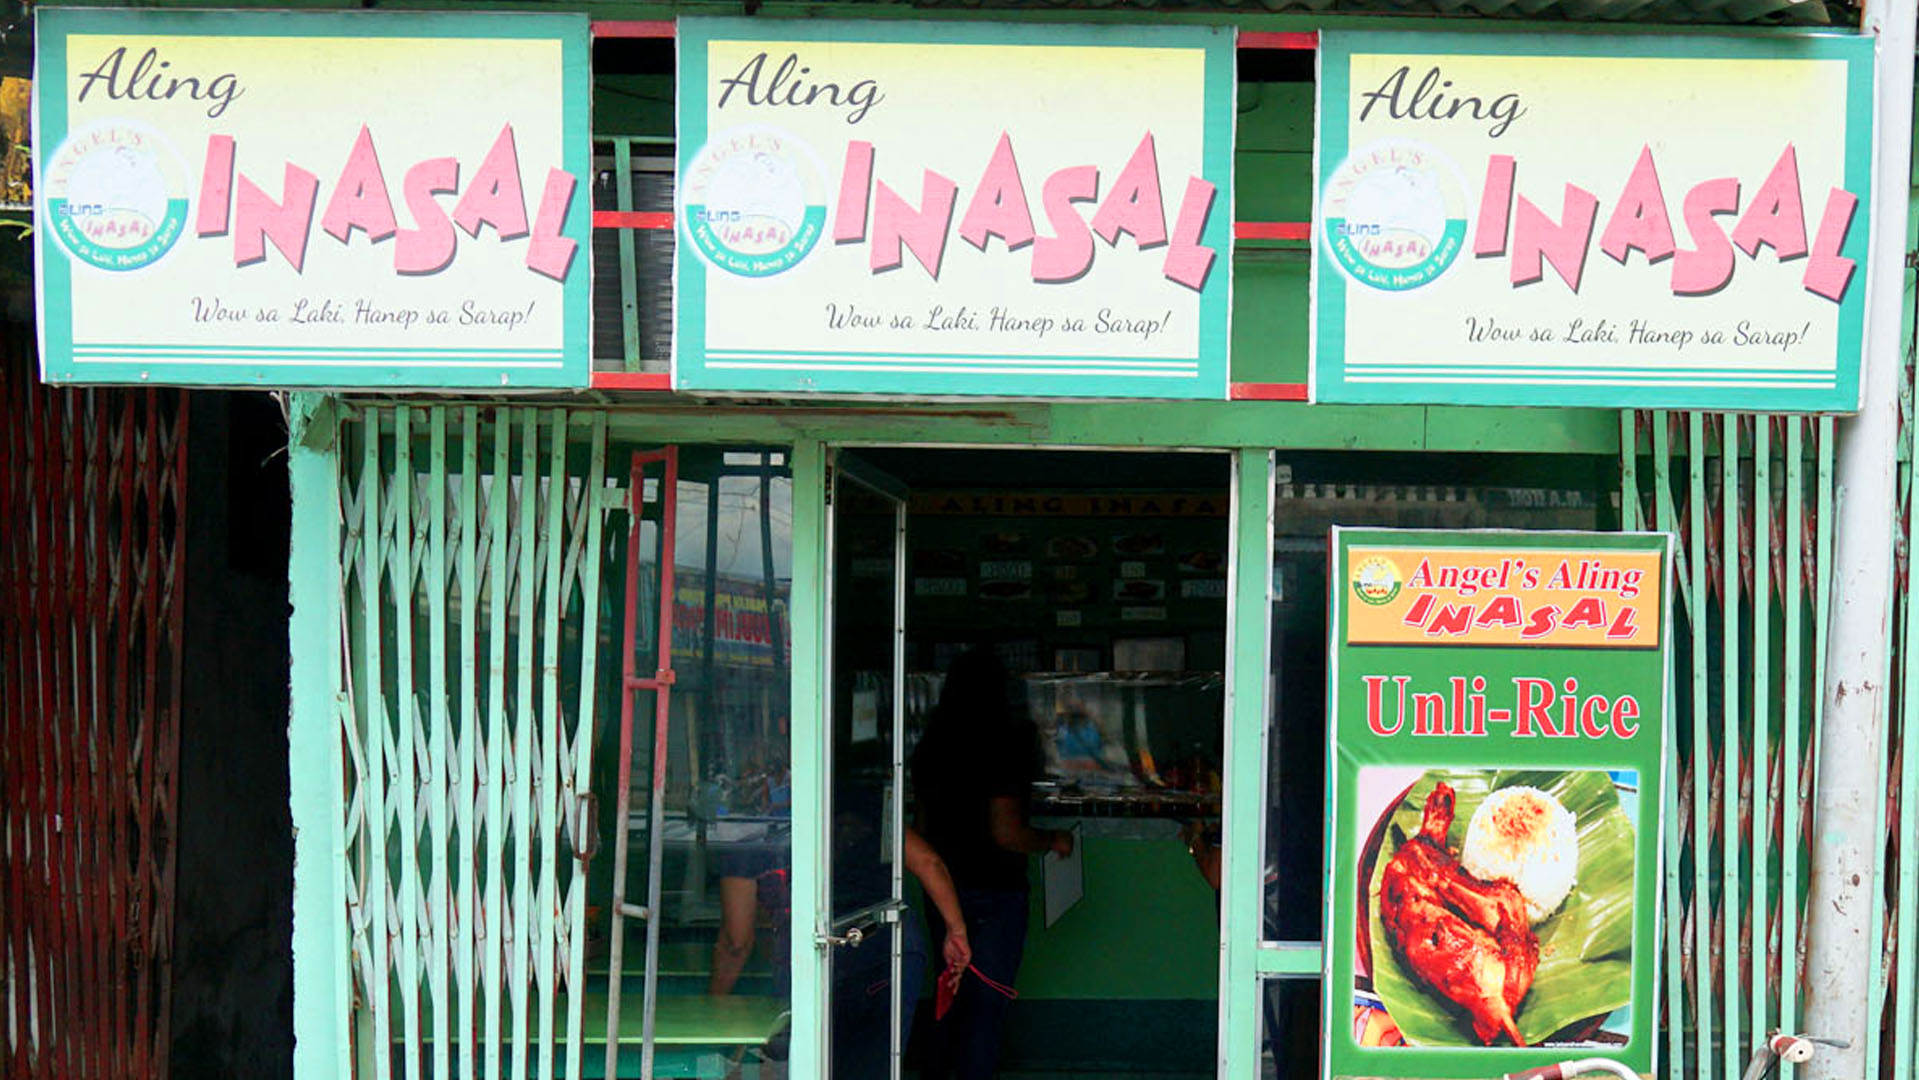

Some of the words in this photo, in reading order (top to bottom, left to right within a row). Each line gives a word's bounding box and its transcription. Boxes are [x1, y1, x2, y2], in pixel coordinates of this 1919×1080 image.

[78, 46, 245, 118] Aling
[717, 53, 886, 124] Aling
[1359, 65, 1528, 138] Aling
[196, 121, 579, 283] INASAL
[832, 129, 1217, 292] INASAL
[1473, 141, 1859, 304] INASAL
[87, 220, 148, 238] INASAL
[722, 226, 786, 244] INASAL
[1363, 240, 1426, 258] INASAL
[192, 296, 245, 323] Wow
[256, 308, 280, 323] sa
[355, 300, 418, 330] Hanep
[427, 310, 449, 325] sa
[458, 301, 535, 331] Sarap!
[825, 303, 881, 329] Wow
[889, 316, 915, 329] sa
[990, 307, 1054, 338] Hanep
[1061, 318, 1085, 332] sa
[1094, 308, 1171, 339] Sarap!
[1465, 317, 1521, 343] Wow
[1529, 328, 1554, 342] sa
[1629, 320, 1694, 350] Hanep
[1700, 331, 1726, 345] sa
[1733, 321, 1810, 353] Sarap!
[940, 495, 1064, 514] ALING
[1090, 495, 1218, 514] INASA
[1408, 557, 1540, 595] Angel's
[1544, 559, 1643, 598] Aling
[1403, 593, 1640, 640] INASAL
[1362, 675, 1641, 739] Unli-Rice
